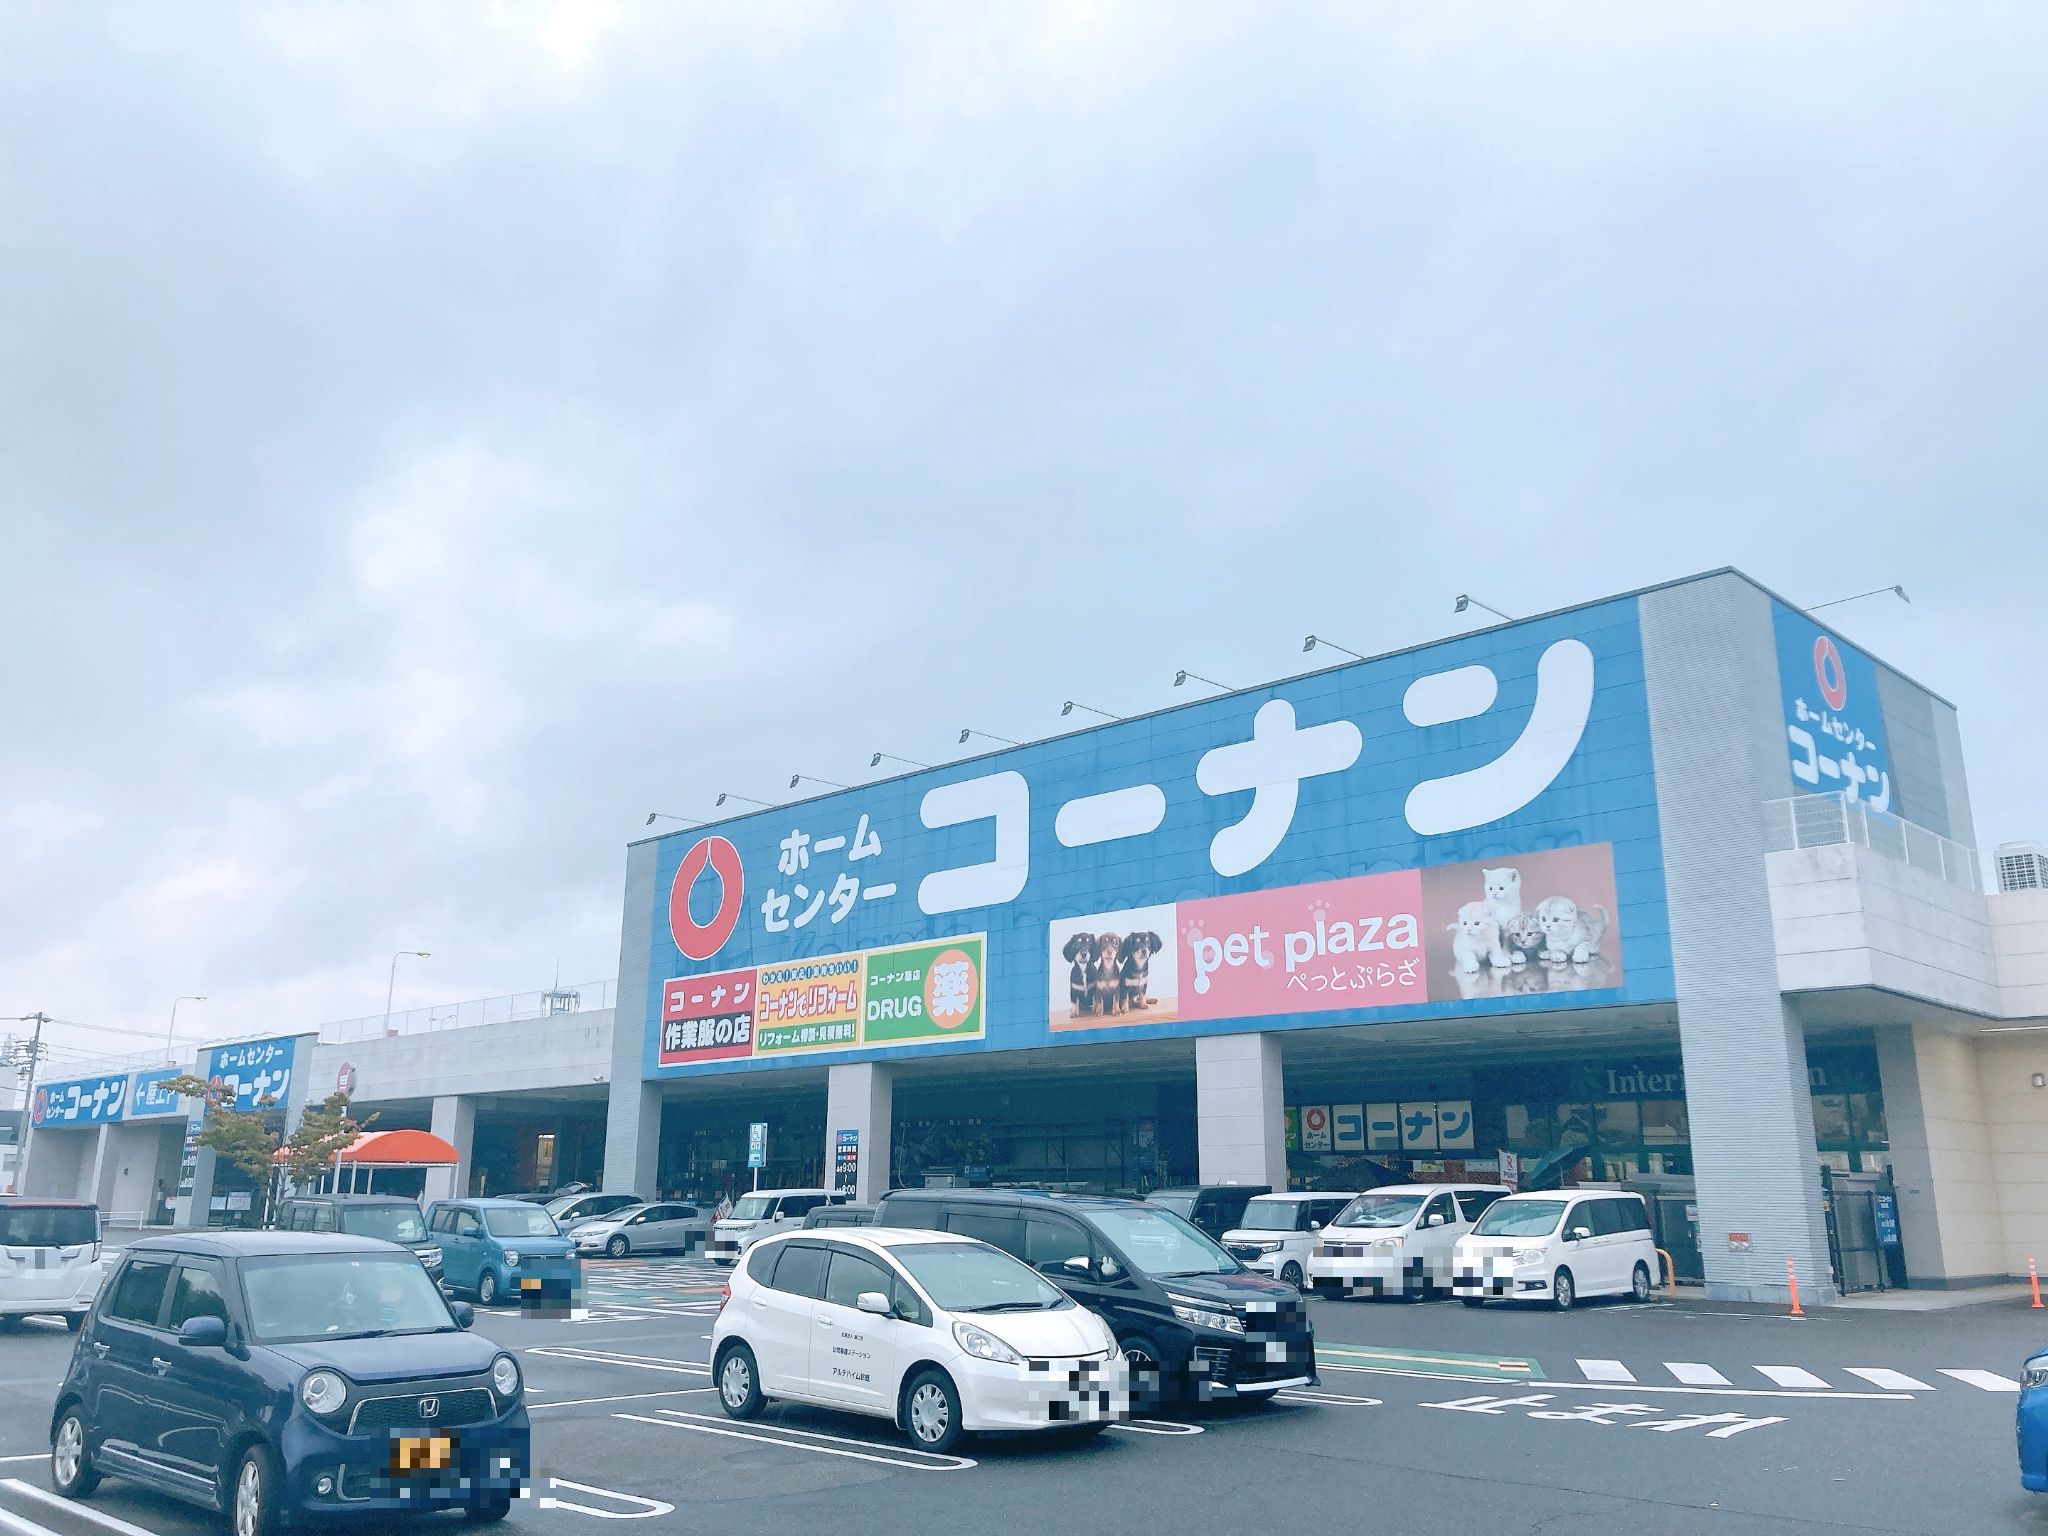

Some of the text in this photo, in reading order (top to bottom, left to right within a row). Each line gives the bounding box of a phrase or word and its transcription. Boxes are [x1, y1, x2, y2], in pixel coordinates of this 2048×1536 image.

[1794, 697, 1877, 751] ホームセンター
[918, 638, 1594, 916] コーナン
[1788, 724, 1891, 812] コーナン
[777, 813, 882, 876] ホーム
[761, 872, 898, 933] センター
[1190, 911, 1419, 994] pet plaza
[933, 961, 969, 1016] 薬
[1286, 957, 1418, 993] ぺっとぷらざ
[670, 982, 750, 1012] コーナン
[759, 980, 858, 1021] コーナンでリフォーム
[867, 996, 922, 1021] DRUG
[665, 1014, 751, 1050] 作業服の店
[219, 1044, 284, 1069] ホームセンター
[64, 1080, 127, 1120] コーナン
[219, 1068, 290, 1107] コーナン
[1304, 1141, 1330, 1149] センター
[1337, 1110, 1471, 1141] コーナン
[1416, 1393, 1791, 1439] 止まれ
